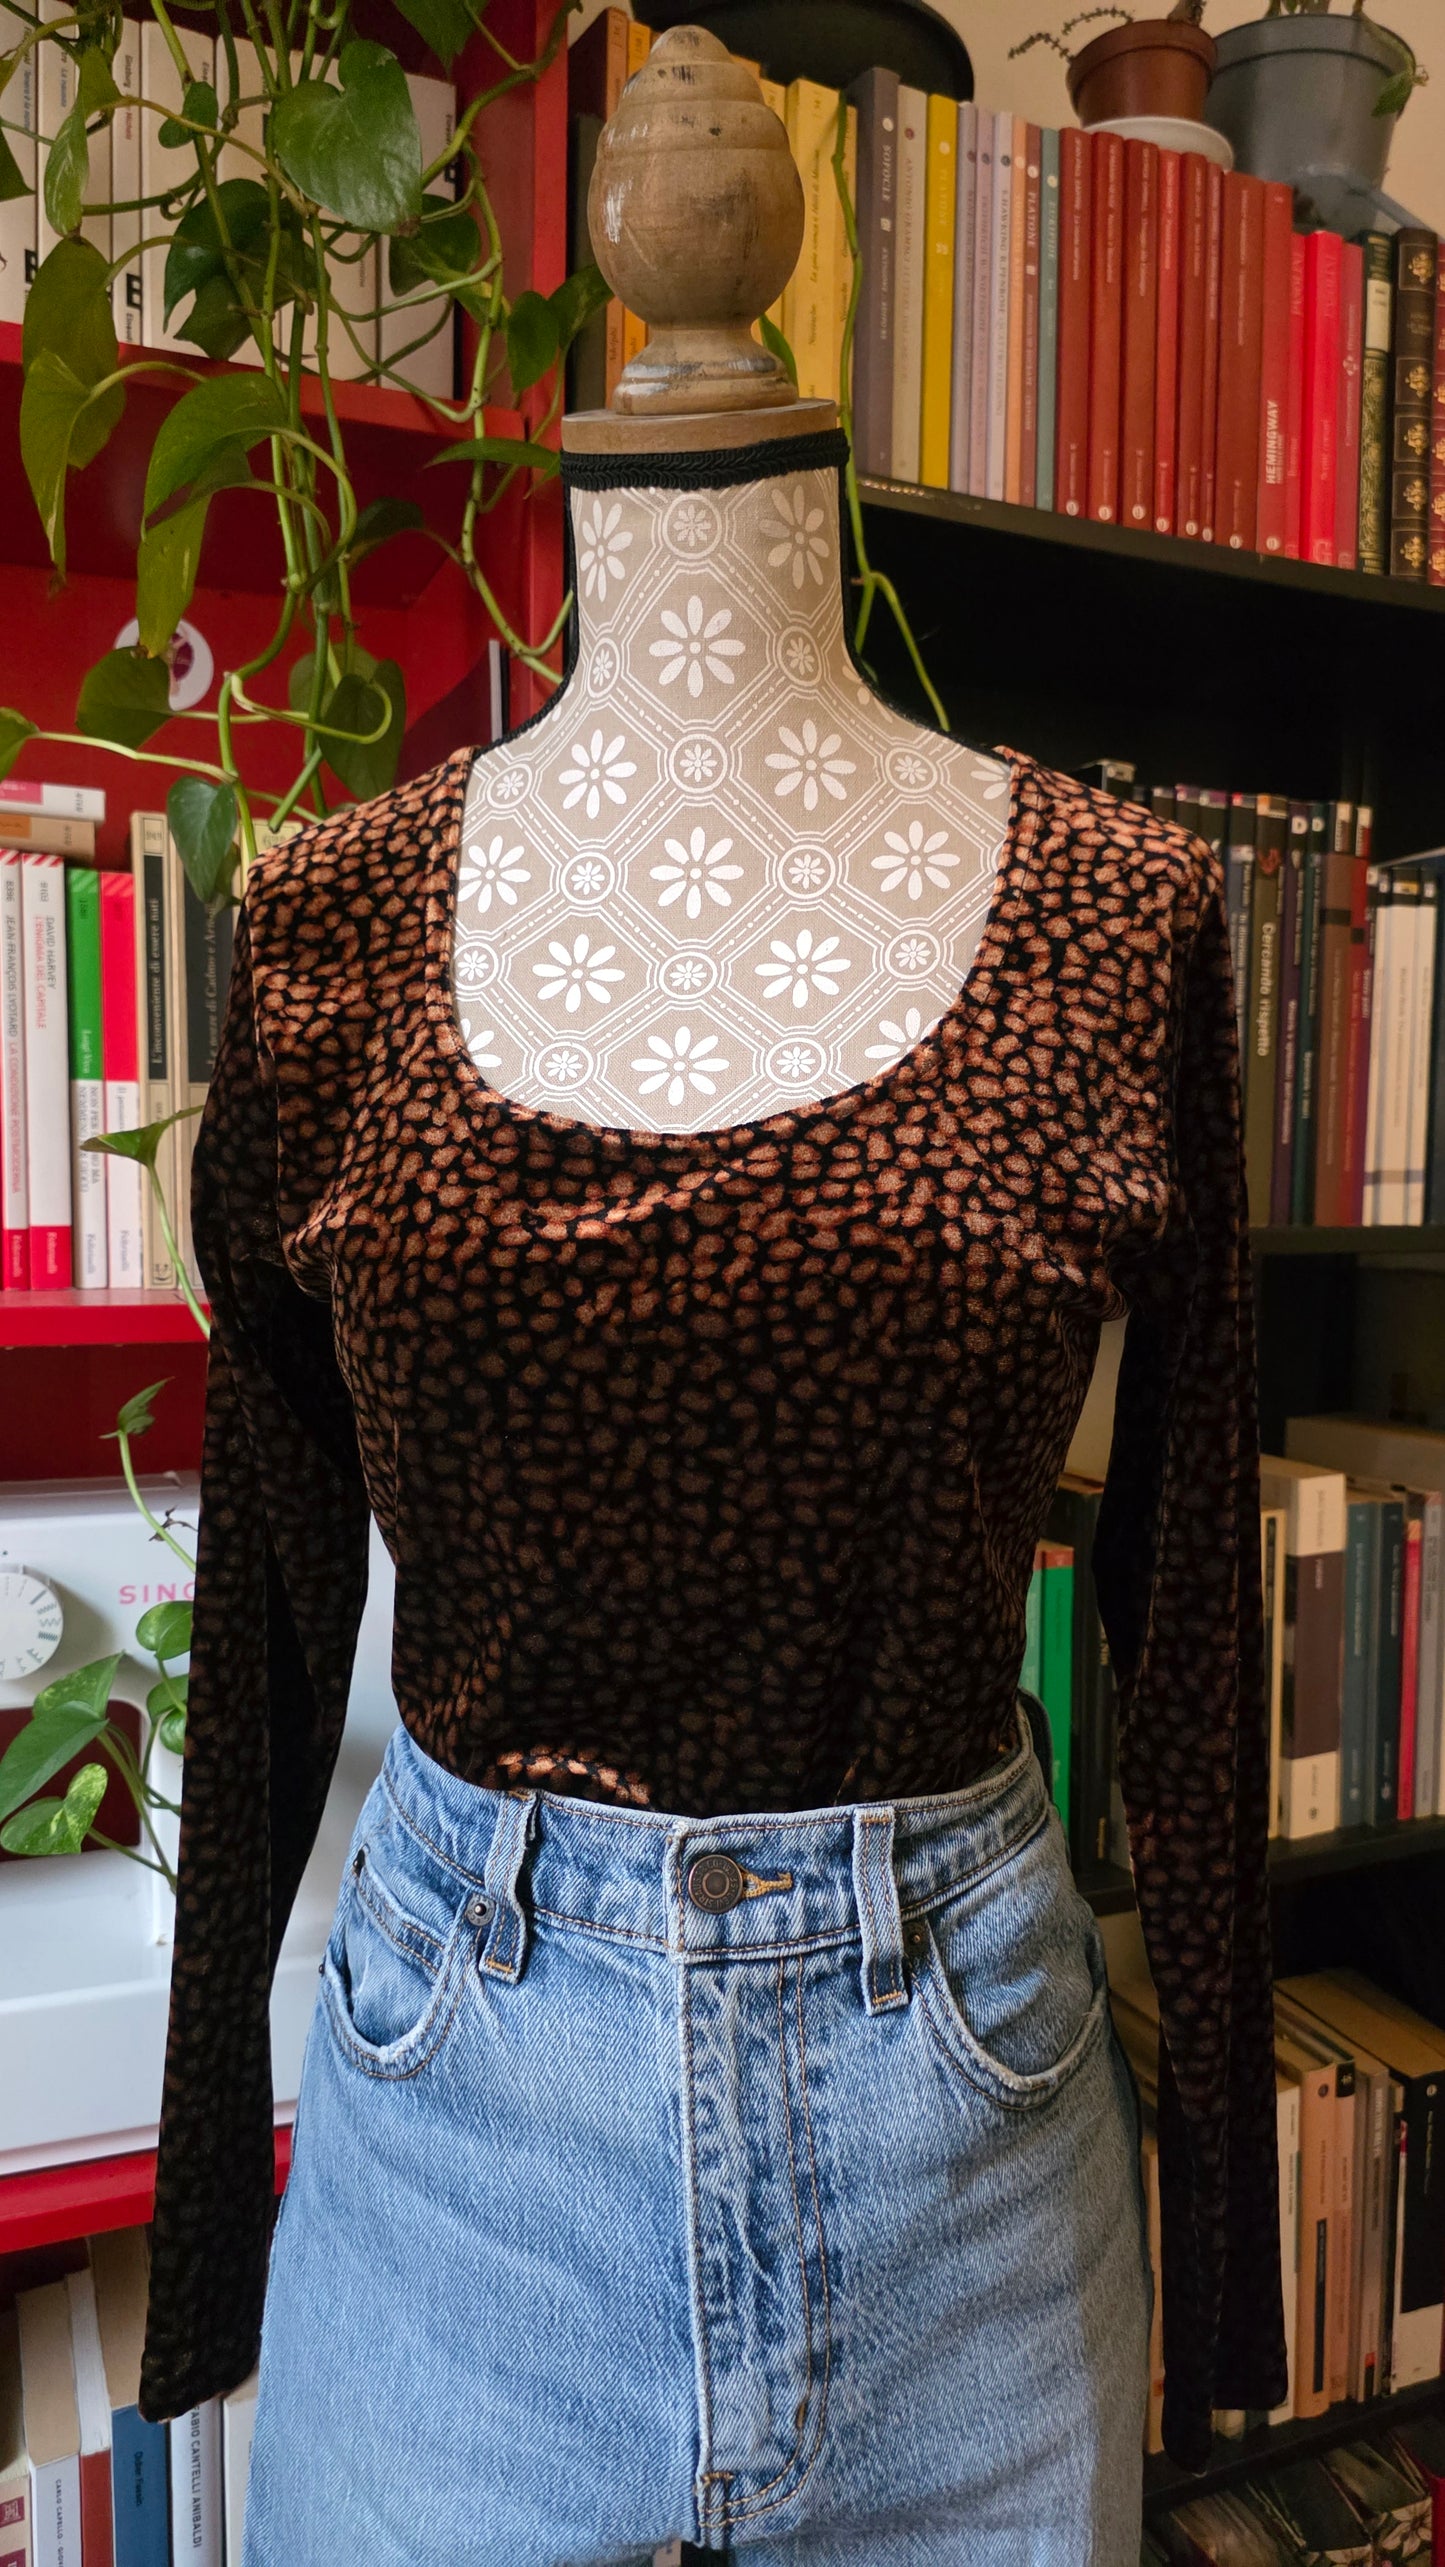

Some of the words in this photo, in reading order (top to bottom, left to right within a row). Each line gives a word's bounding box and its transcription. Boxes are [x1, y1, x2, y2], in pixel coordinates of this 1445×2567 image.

[124, 54, 133, 89] Ginzburg
[882, 144, 892, 203] SOFOCLE
[904, 157, 913, 210] ANTONIO
[903, 211, 913, 263] GRAMSCI
[1028, 191, 1037, 249] PLATONE
[1047, 199, 1057, 262] EURIPIDE
[1265, 400, 1279, 484] HEMINGWAY
[46, 916, 56, 947] DAVID
[149, 898, 161, 922] nati
[148, 960, 161, 974] di
[150, 925, 161, 959] essere
[1260, 921, 1277, 995] Cercando
[36, 965, 46, 983] DEL
[47, 949, 57, 990] HARVEY
[8, 993, 18, 1037] LYOTARD
[36, 984, 47, 1030] CAPITALE
[150, 977, 163, 1065] L'inconveniente
[1255, 998, 1273, 1057] rispetto
[191, 2440, 201, 2494] CANTELLI
[56, 2505, 64, 2540] CAPELLO
[192, 2497, 202, 2548] ANIBALDI
